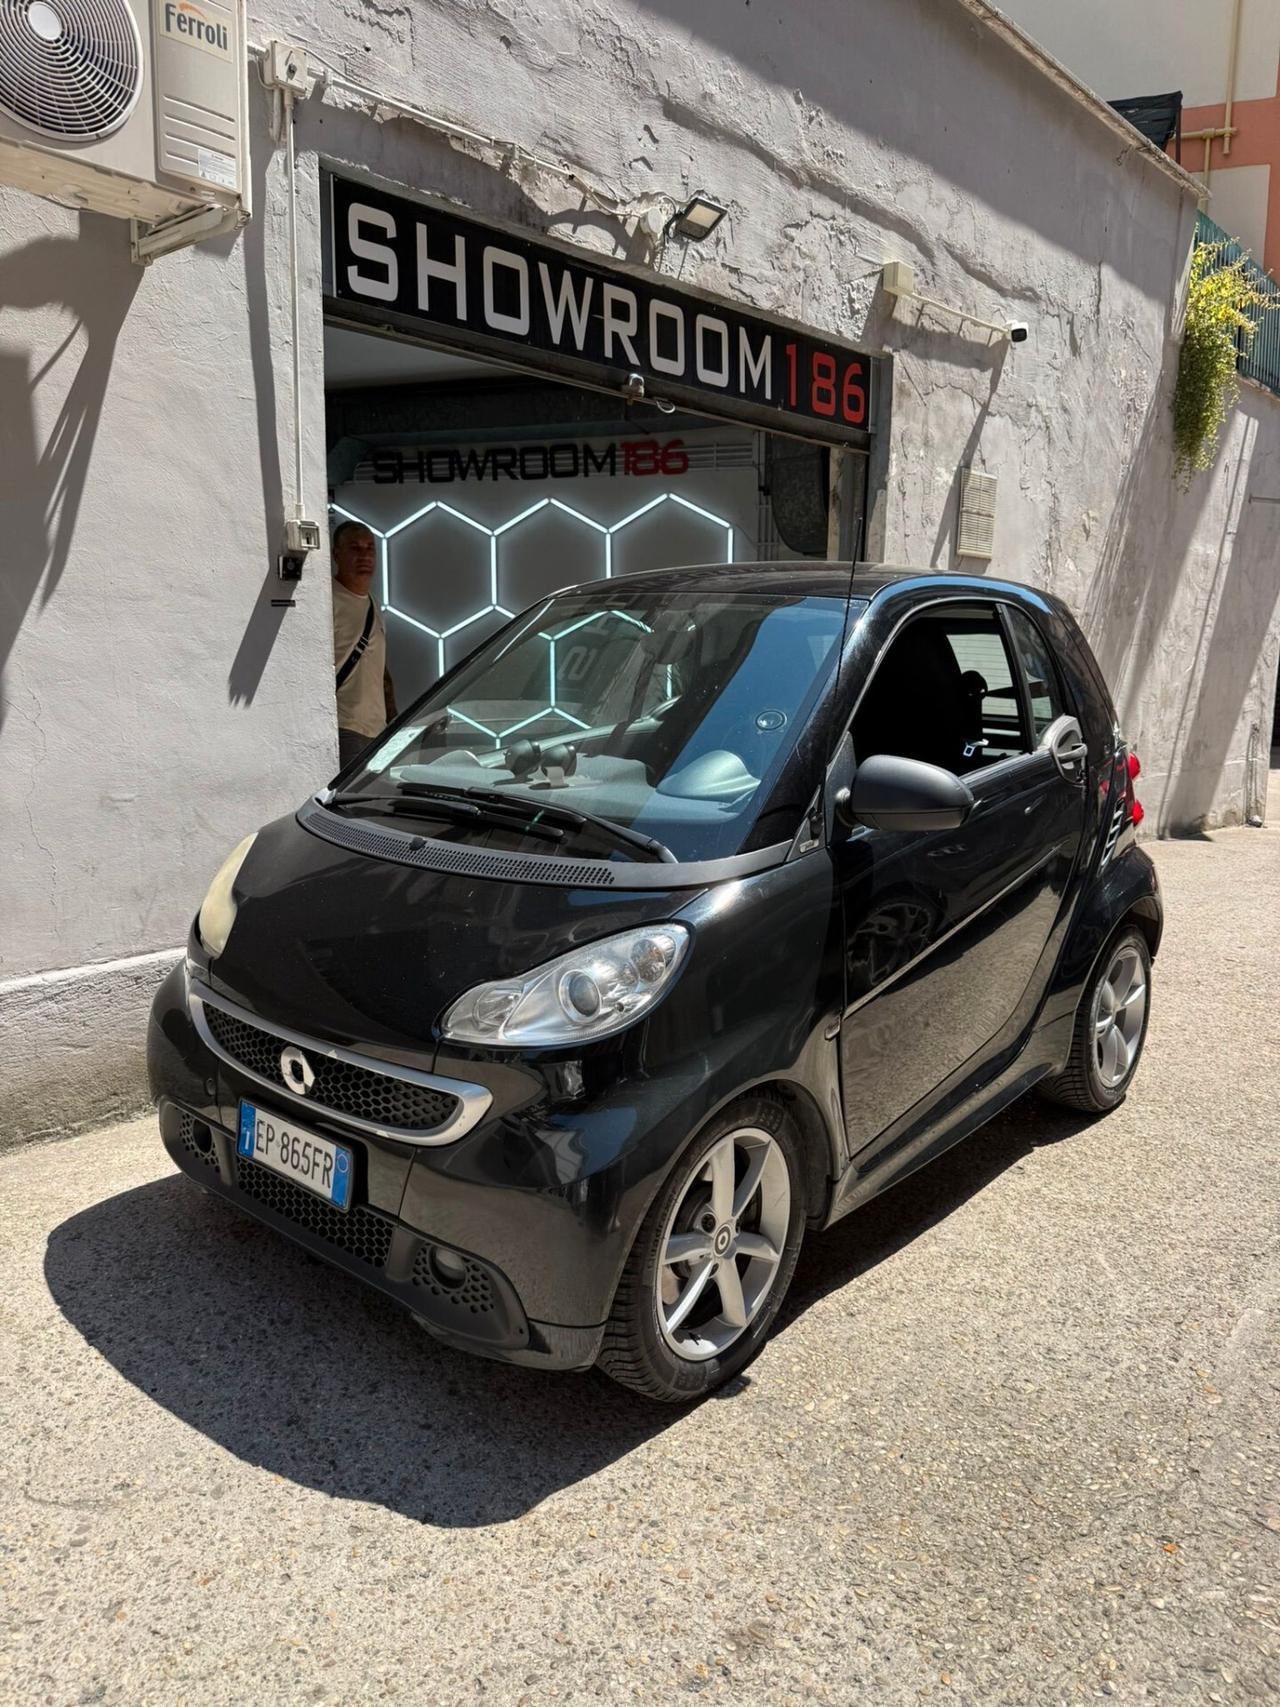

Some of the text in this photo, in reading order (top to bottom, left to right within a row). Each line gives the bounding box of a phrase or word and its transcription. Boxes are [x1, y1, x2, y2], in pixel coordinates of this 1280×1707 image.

[165, 3, 228, 51] Ferroli
[255, 1119, 275, 1155] EP
[280, 1131, 334, 1189] 865FR
